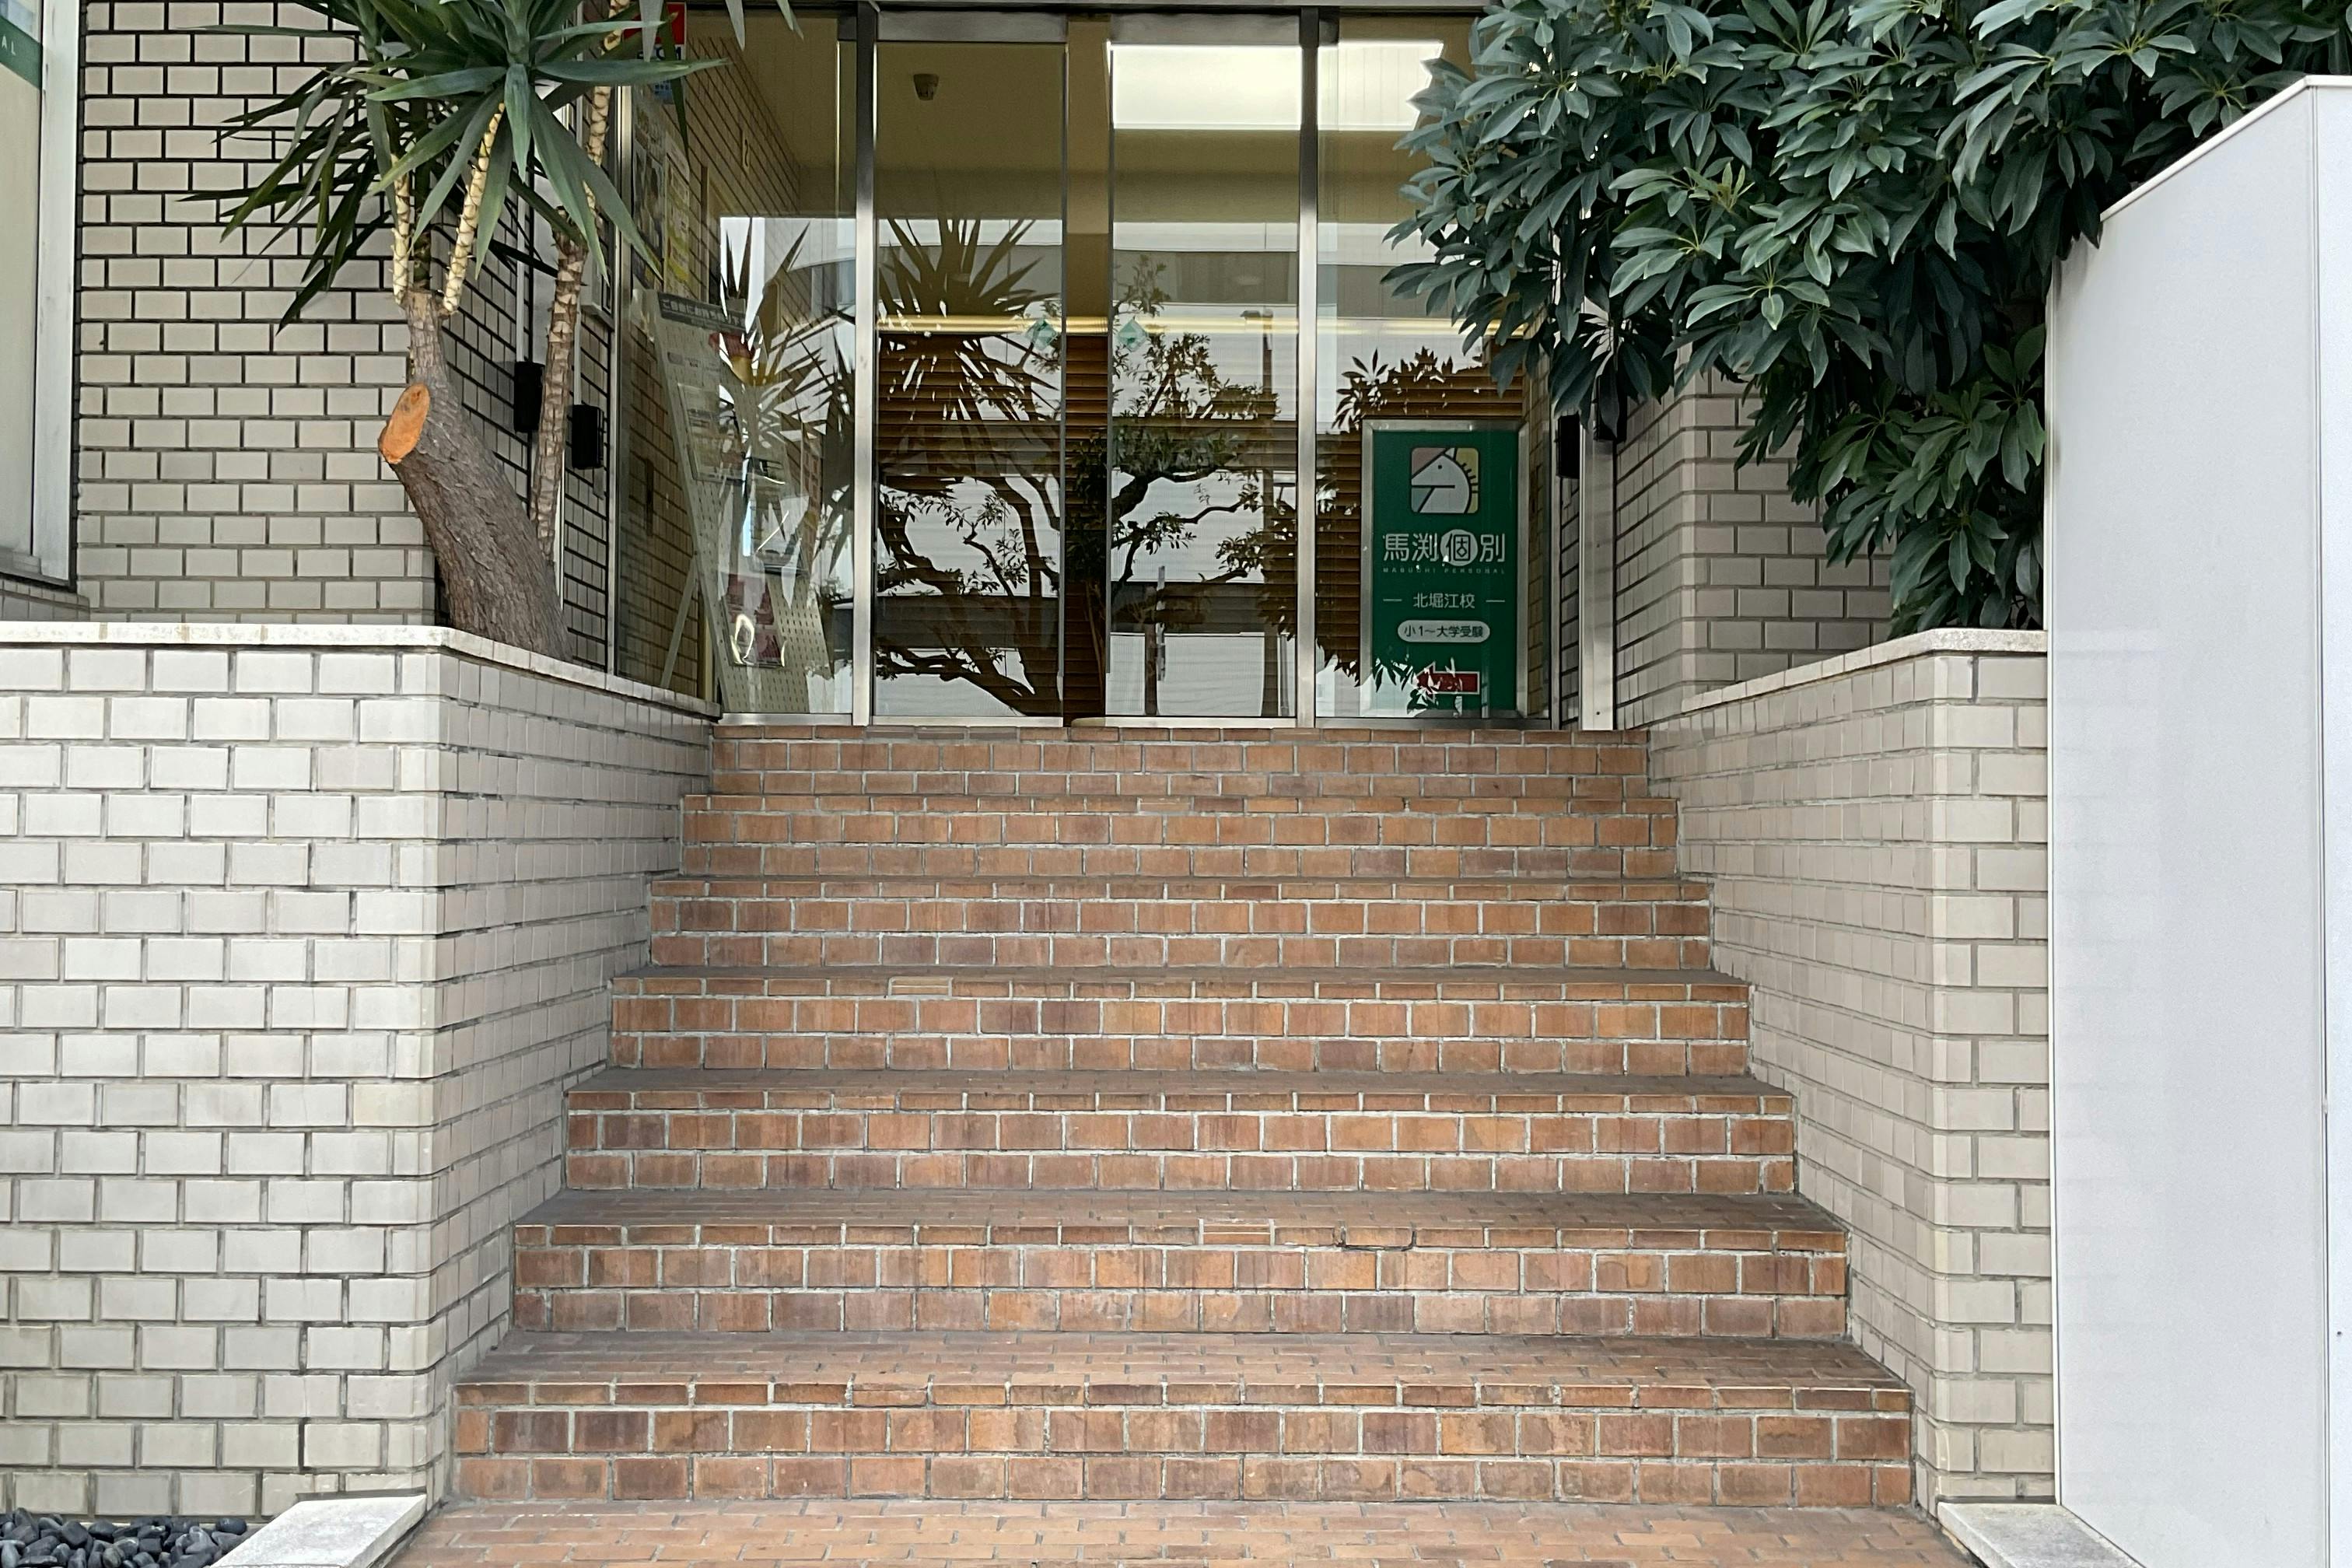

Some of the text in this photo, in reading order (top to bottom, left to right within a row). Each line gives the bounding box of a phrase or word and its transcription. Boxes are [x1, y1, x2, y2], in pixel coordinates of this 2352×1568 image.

[1383, 531, 1506, 563] 馬渕個別
[1412, 592, 1475, 608] 北堀江校
